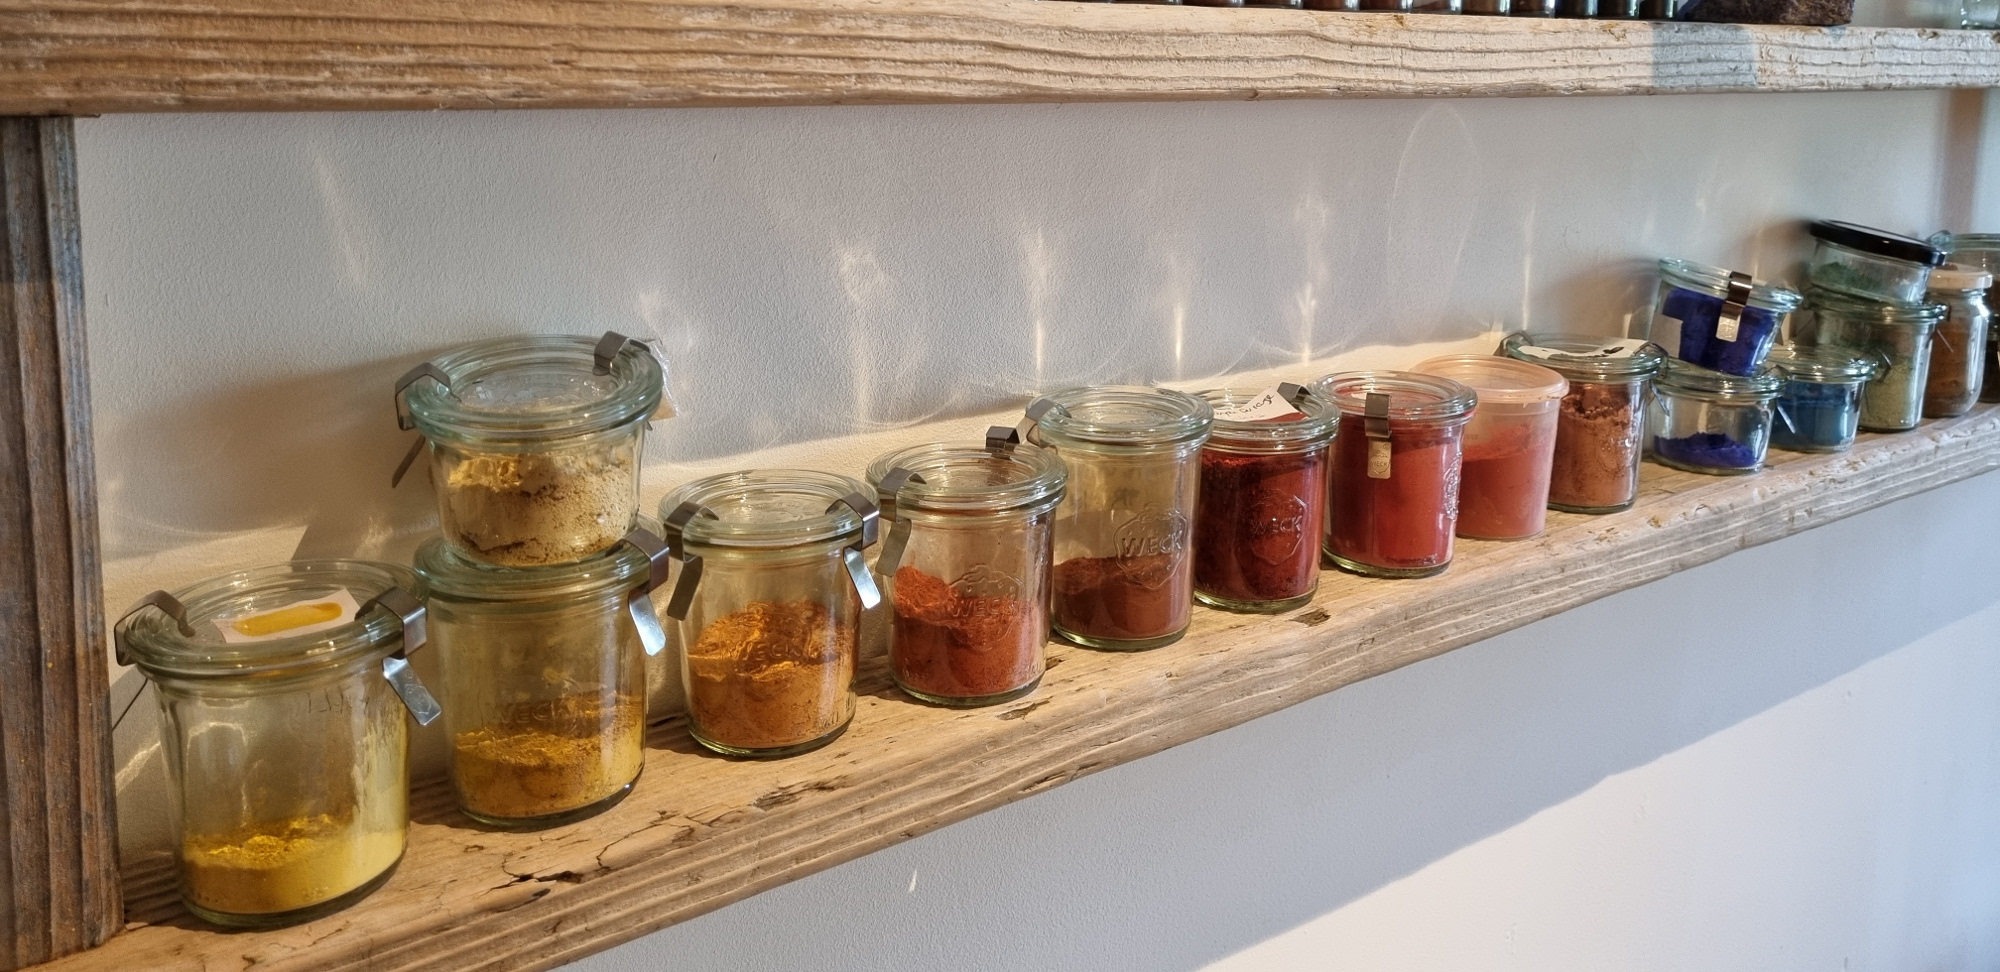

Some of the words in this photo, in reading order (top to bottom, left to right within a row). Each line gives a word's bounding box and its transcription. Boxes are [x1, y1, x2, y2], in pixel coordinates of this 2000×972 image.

[1250, 514, 1303, 535] WECK
[1121, 530, 1182, 557] WECK
[951, 597, 1017, 617] WECK
